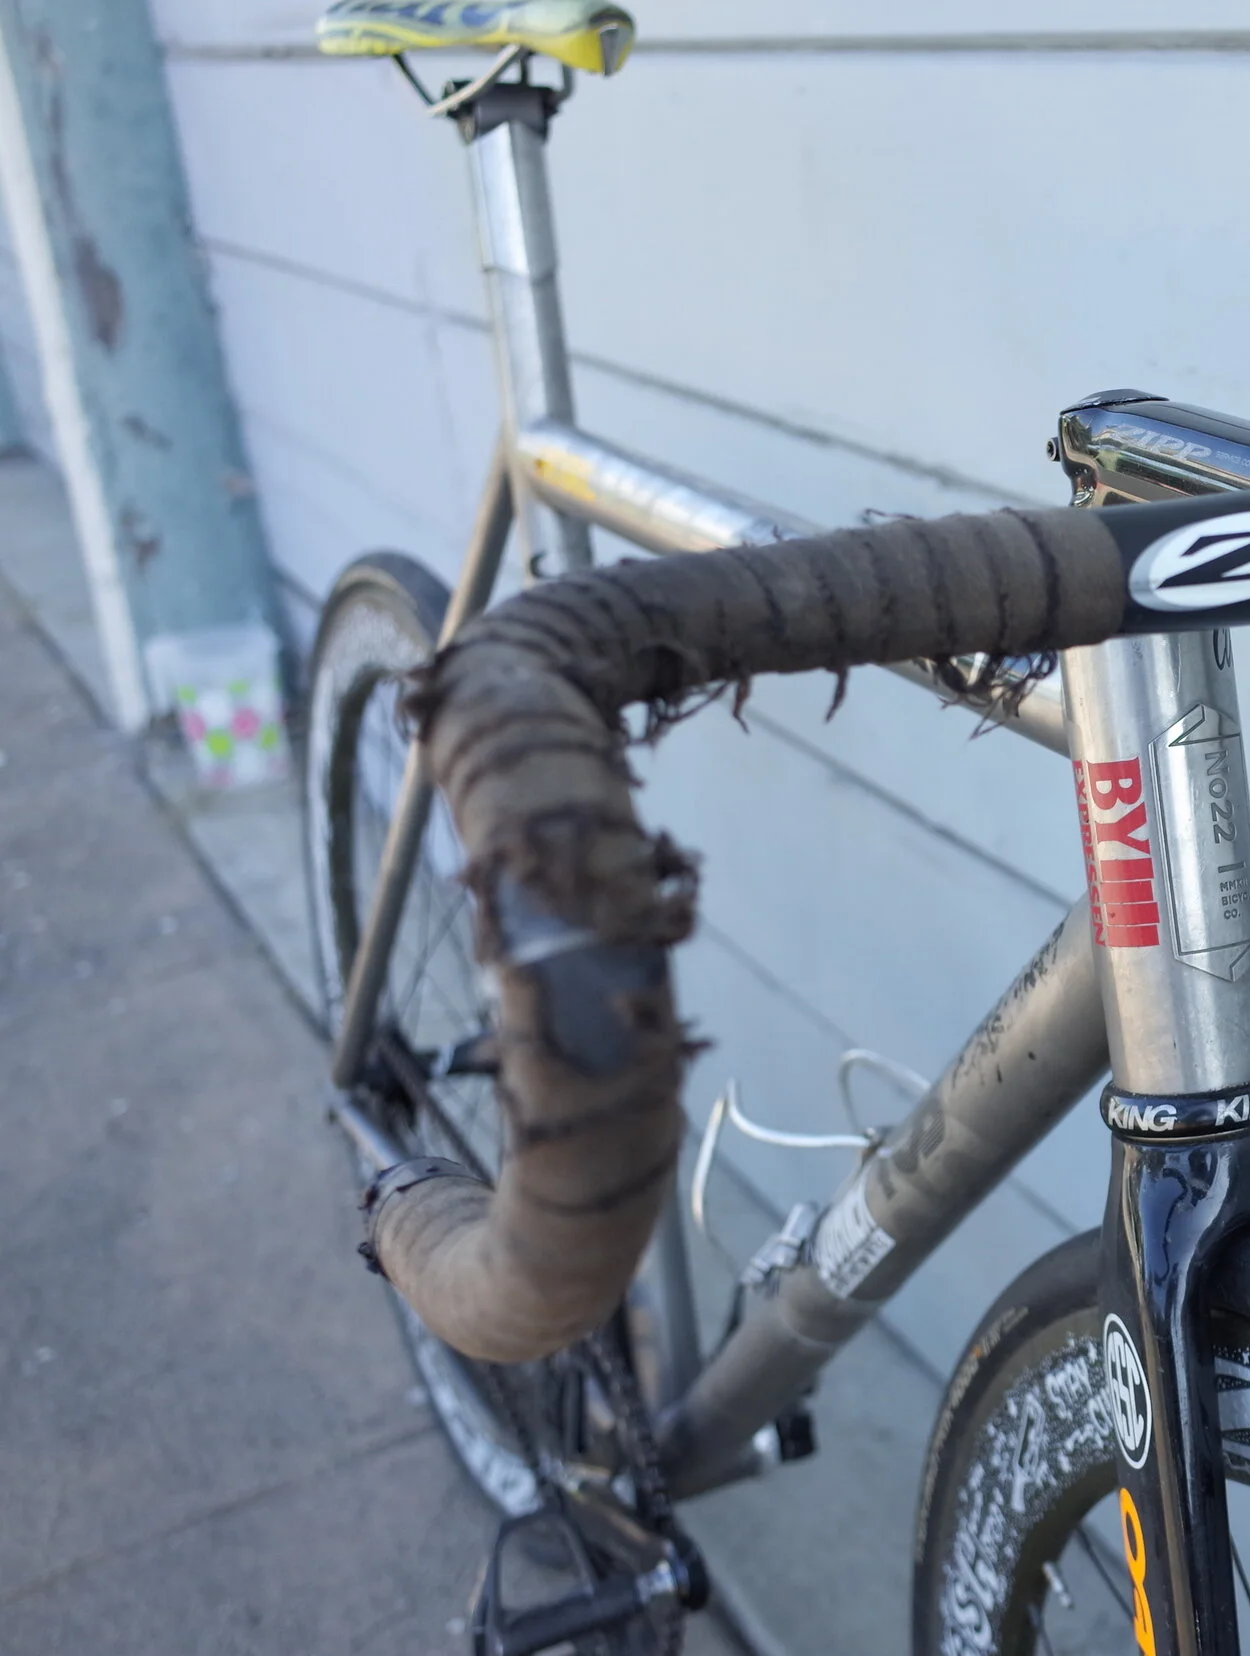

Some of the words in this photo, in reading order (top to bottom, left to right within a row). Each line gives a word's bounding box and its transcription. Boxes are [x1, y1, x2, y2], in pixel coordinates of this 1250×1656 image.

[1109, 423, 1212, 461] ZIPP
[1072, 759, 1107, 947] EXPRESSEN
[1107, 1096, 1178, 1132] KING
